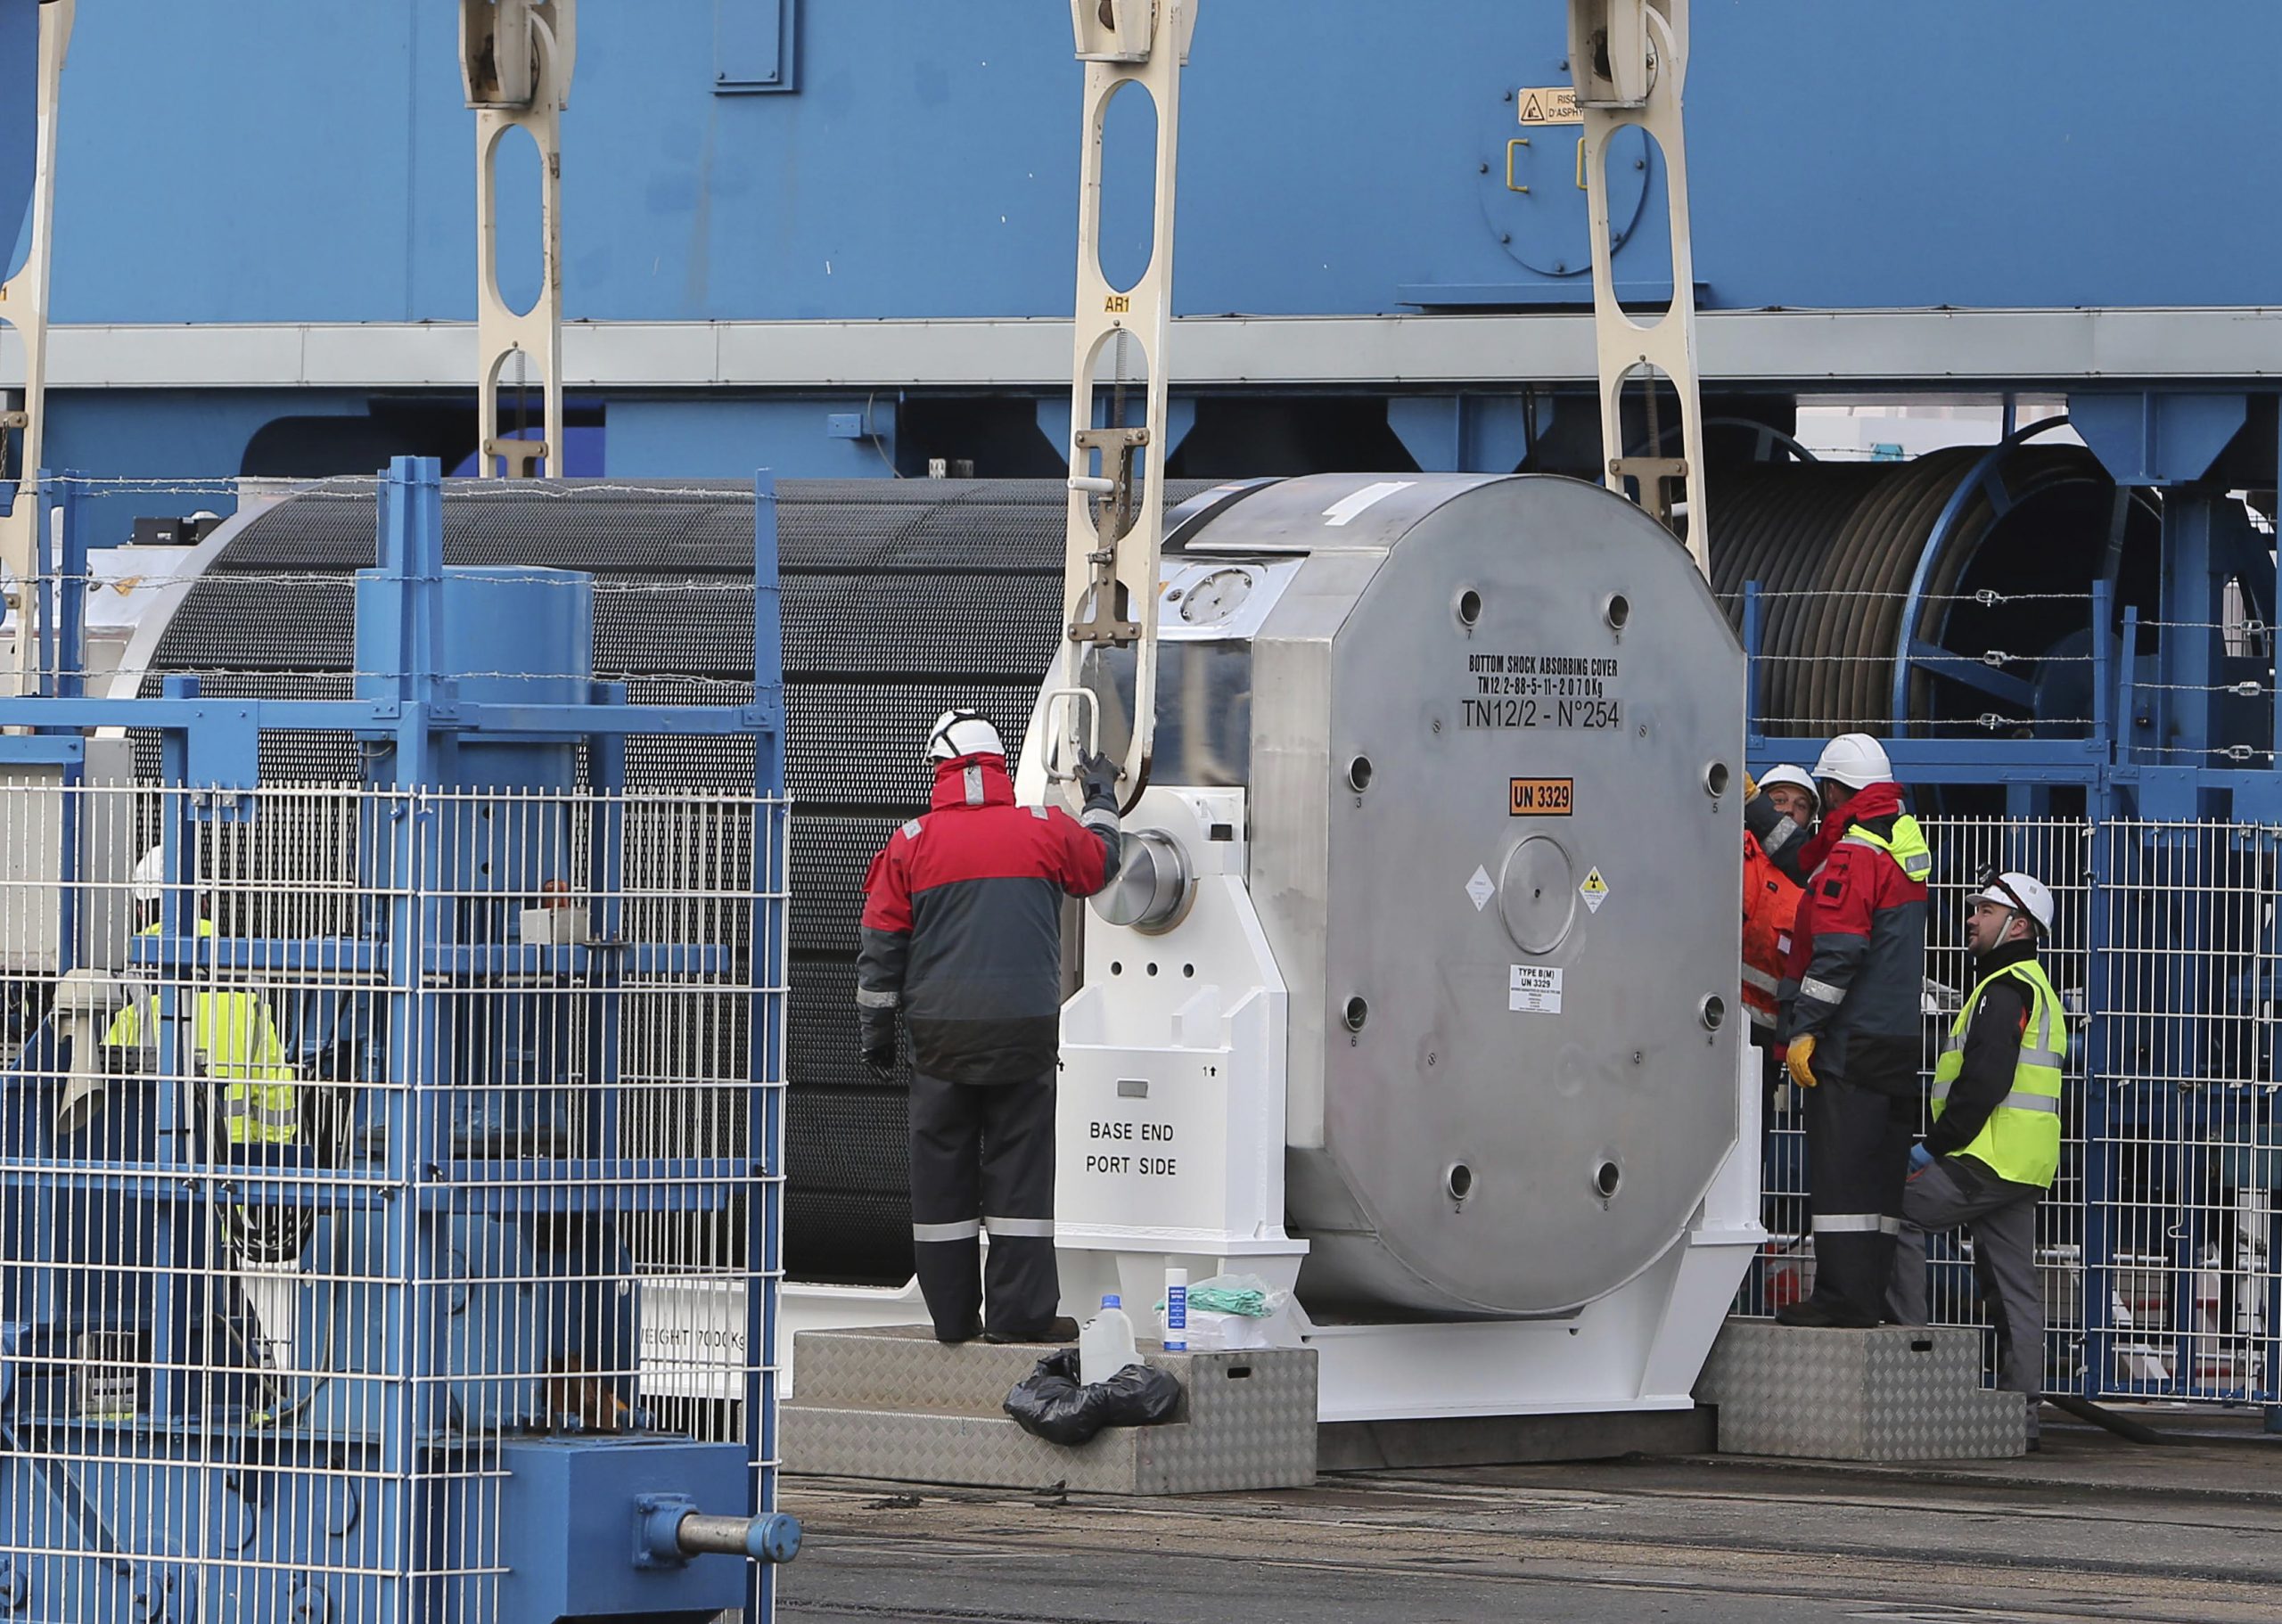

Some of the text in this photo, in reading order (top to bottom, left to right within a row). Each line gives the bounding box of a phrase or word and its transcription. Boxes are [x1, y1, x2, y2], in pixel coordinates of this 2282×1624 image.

[1104, 296, 1129, 312] AR1
[1469, 654, 1618, 677] BOTTOM SHOCK ABSORBING COVER
[1462, 700, 1537, 727] TN12/2
[1558, 700, 1620, 727] N°254
[1356, 797, 1362, 808] 3
[1514, 785, 1569, 808] UN 3329
[1712, 802, 1719, 813] 5
[1519, 968, 1537, 977] TYPE
[1521, 978, 1551, 988] UN 3329
[1350, 1036, 1357, 1047] 6
[1090, 1122, 1174, 1142] BASE END
[1087, 1155, 1177, 1176] PORT SIDE
[1455, 1202, 1461, 1214] 2
